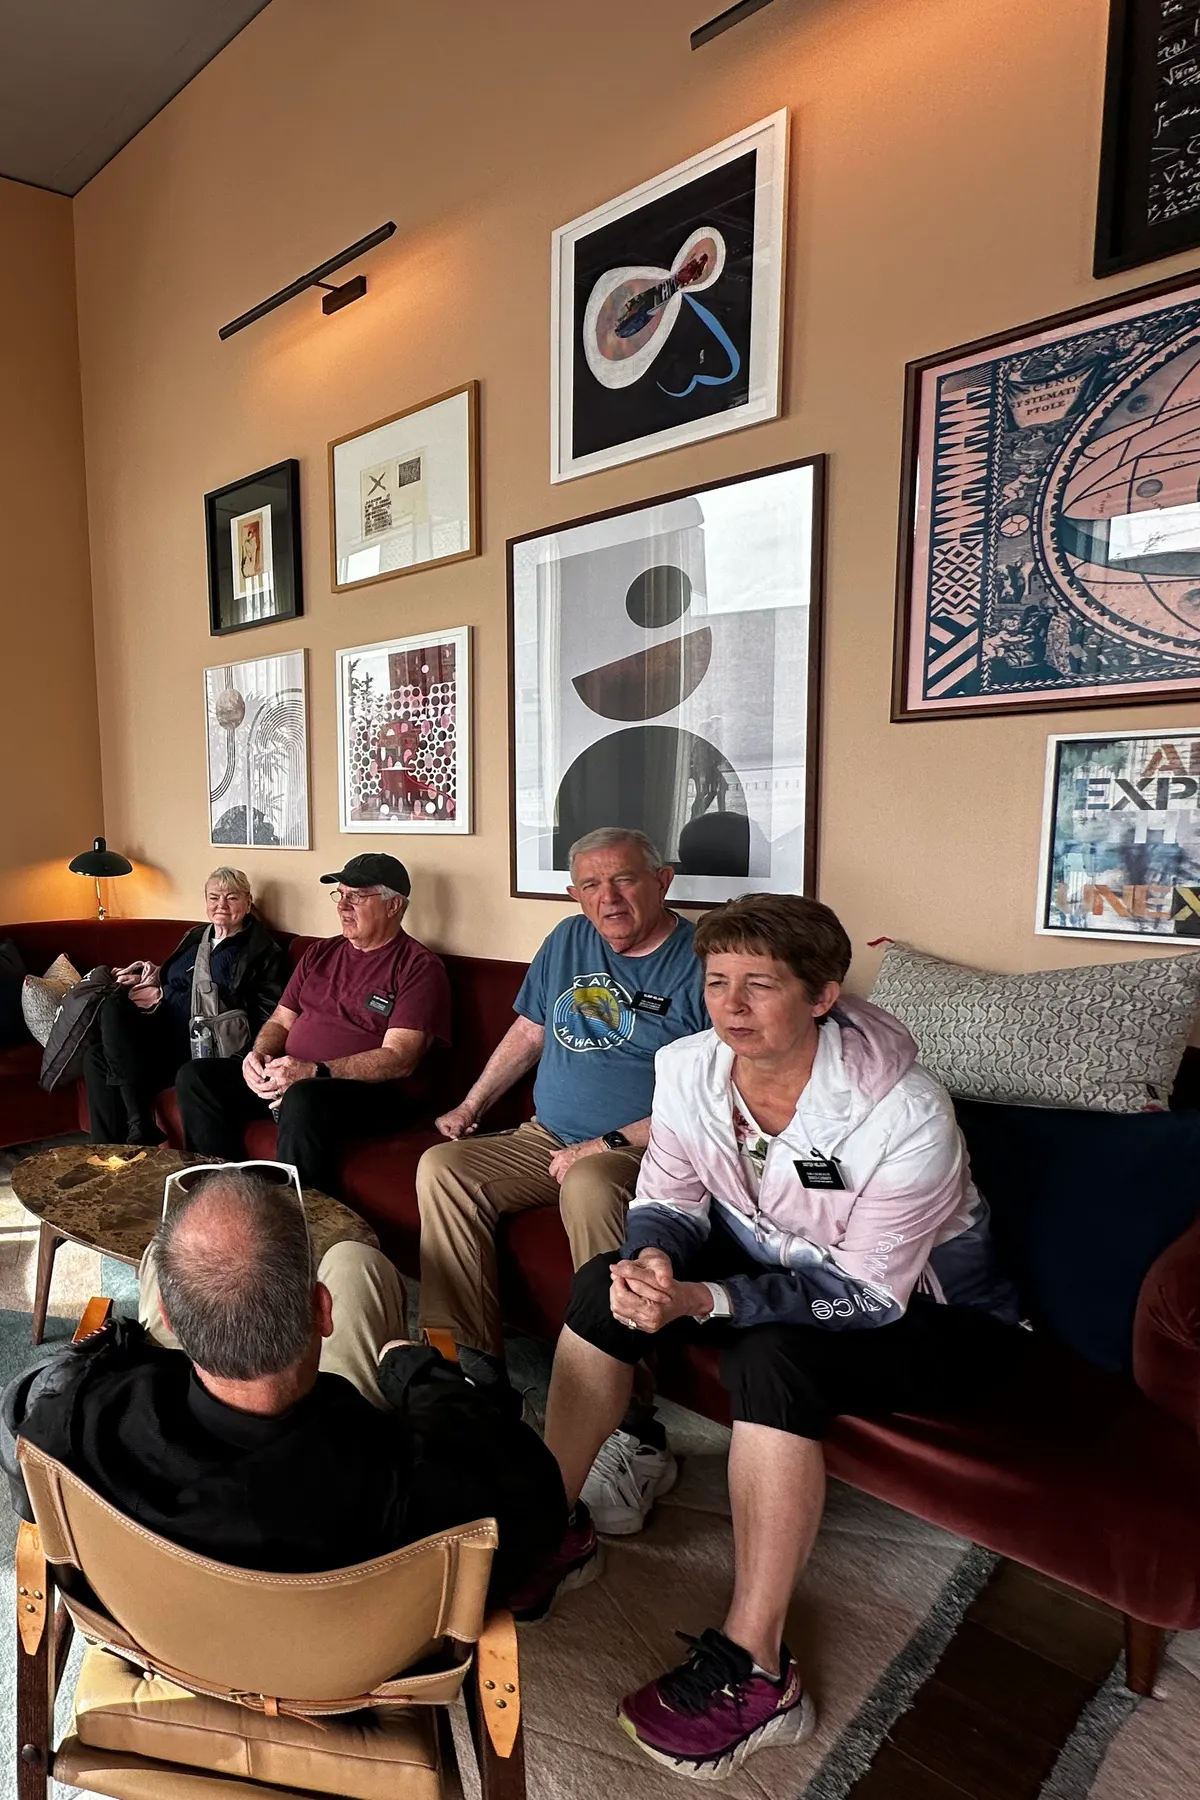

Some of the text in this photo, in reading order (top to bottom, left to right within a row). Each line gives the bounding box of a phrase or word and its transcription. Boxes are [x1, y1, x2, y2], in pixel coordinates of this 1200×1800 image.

[1140, 742, 1200, 776] A
[1074, 777, 1200, 811] EXP
[557, 1025, 610, 1048] HAWAII
